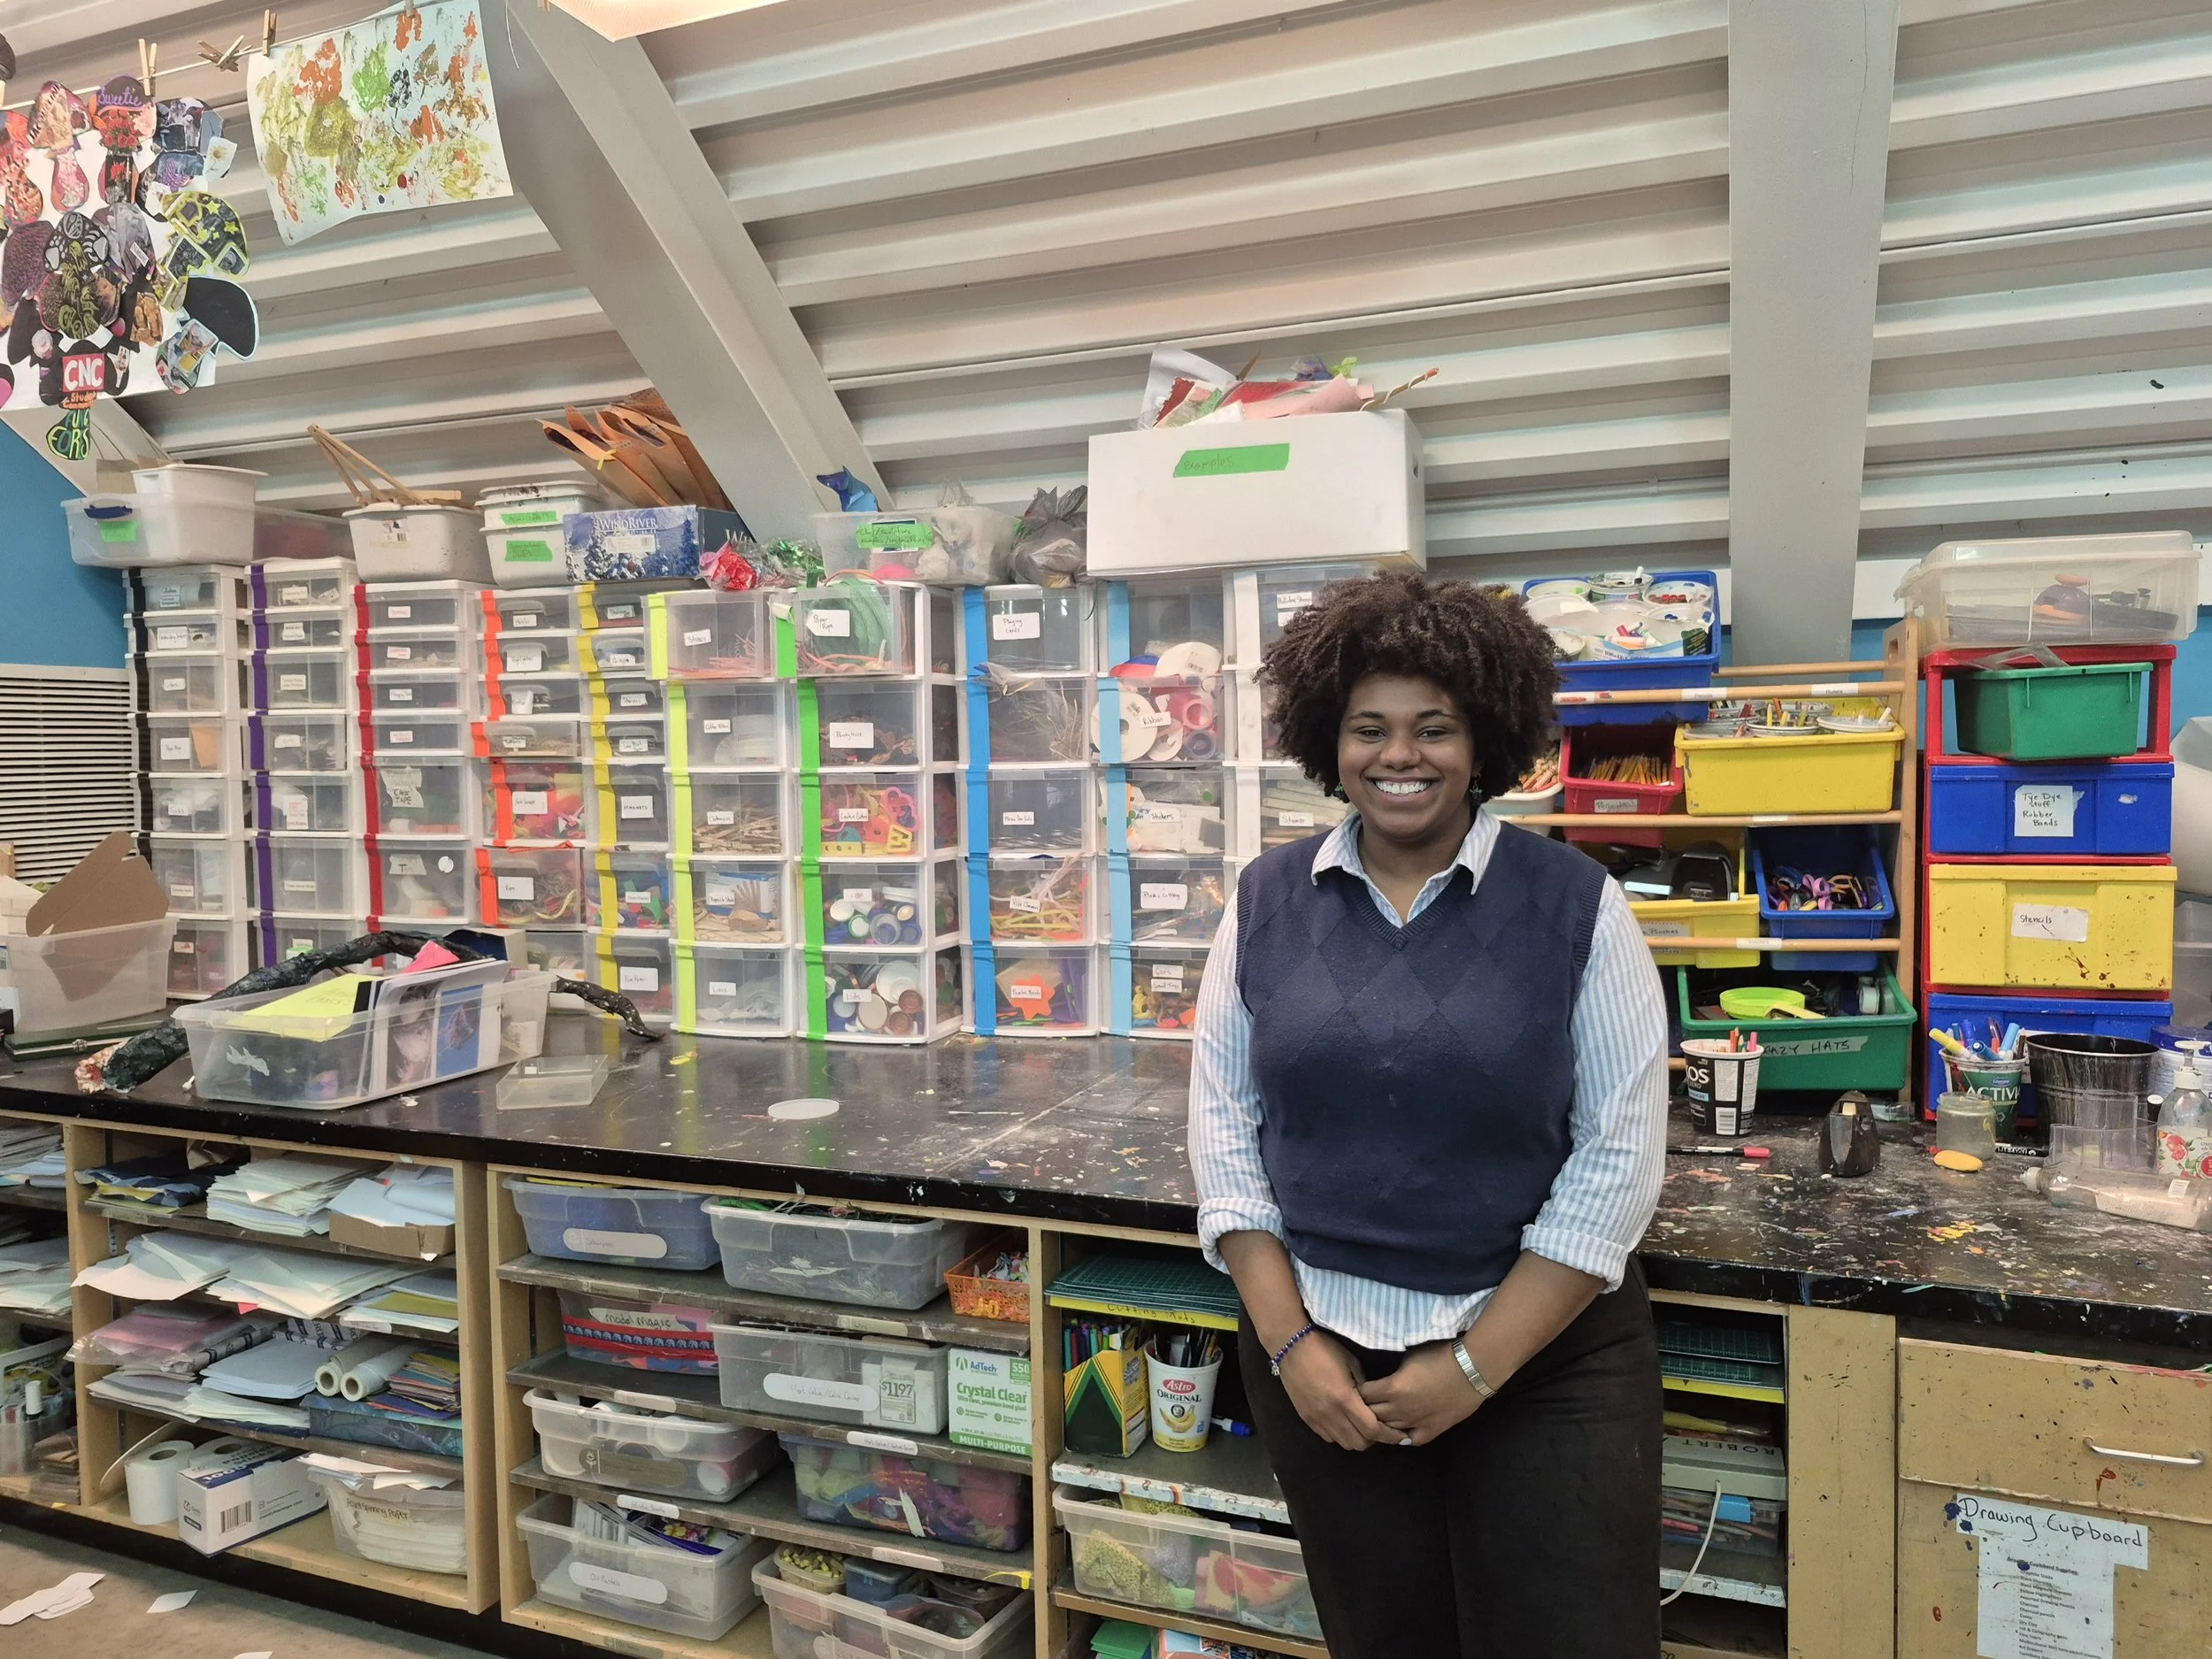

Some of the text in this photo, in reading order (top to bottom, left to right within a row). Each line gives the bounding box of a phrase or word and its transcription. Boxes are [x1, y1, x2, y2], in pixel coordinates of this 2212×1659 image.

[99, 86, 142, 106] Sweetie
[64, 357, 104, 391] CNC
[1184, 455, 1234, 471] examples
[1003, 618, 1023, 627] Playing
[1143, 715, 1164, 726] Ribbon
[2042, 792, 2062, 803] Dye
[1151, 811, 1175, 821] Stickers
[2032, 818, 2059, 826] Bands
[2019, 914, 2053, 925] Stencils
[1764, 1040, 1850, 1056] RAZY HATS
[1107, 1302, 1157, 1318] Cutting
[971, 1361, 997, 1372] AdTech
[1012, 1362, 1030, 1374] 550
[1167, 1379, 1192, 1392] Astro
[956, 1382, 1027, 1404] Crystal Clear
[959, 1434, 1026, 1455] MULTI-PURPOSE
[1682, 1436, 1776, 1456] ROBERT
[1959, 1497, 2143, 1548] Drawing Cupboard
